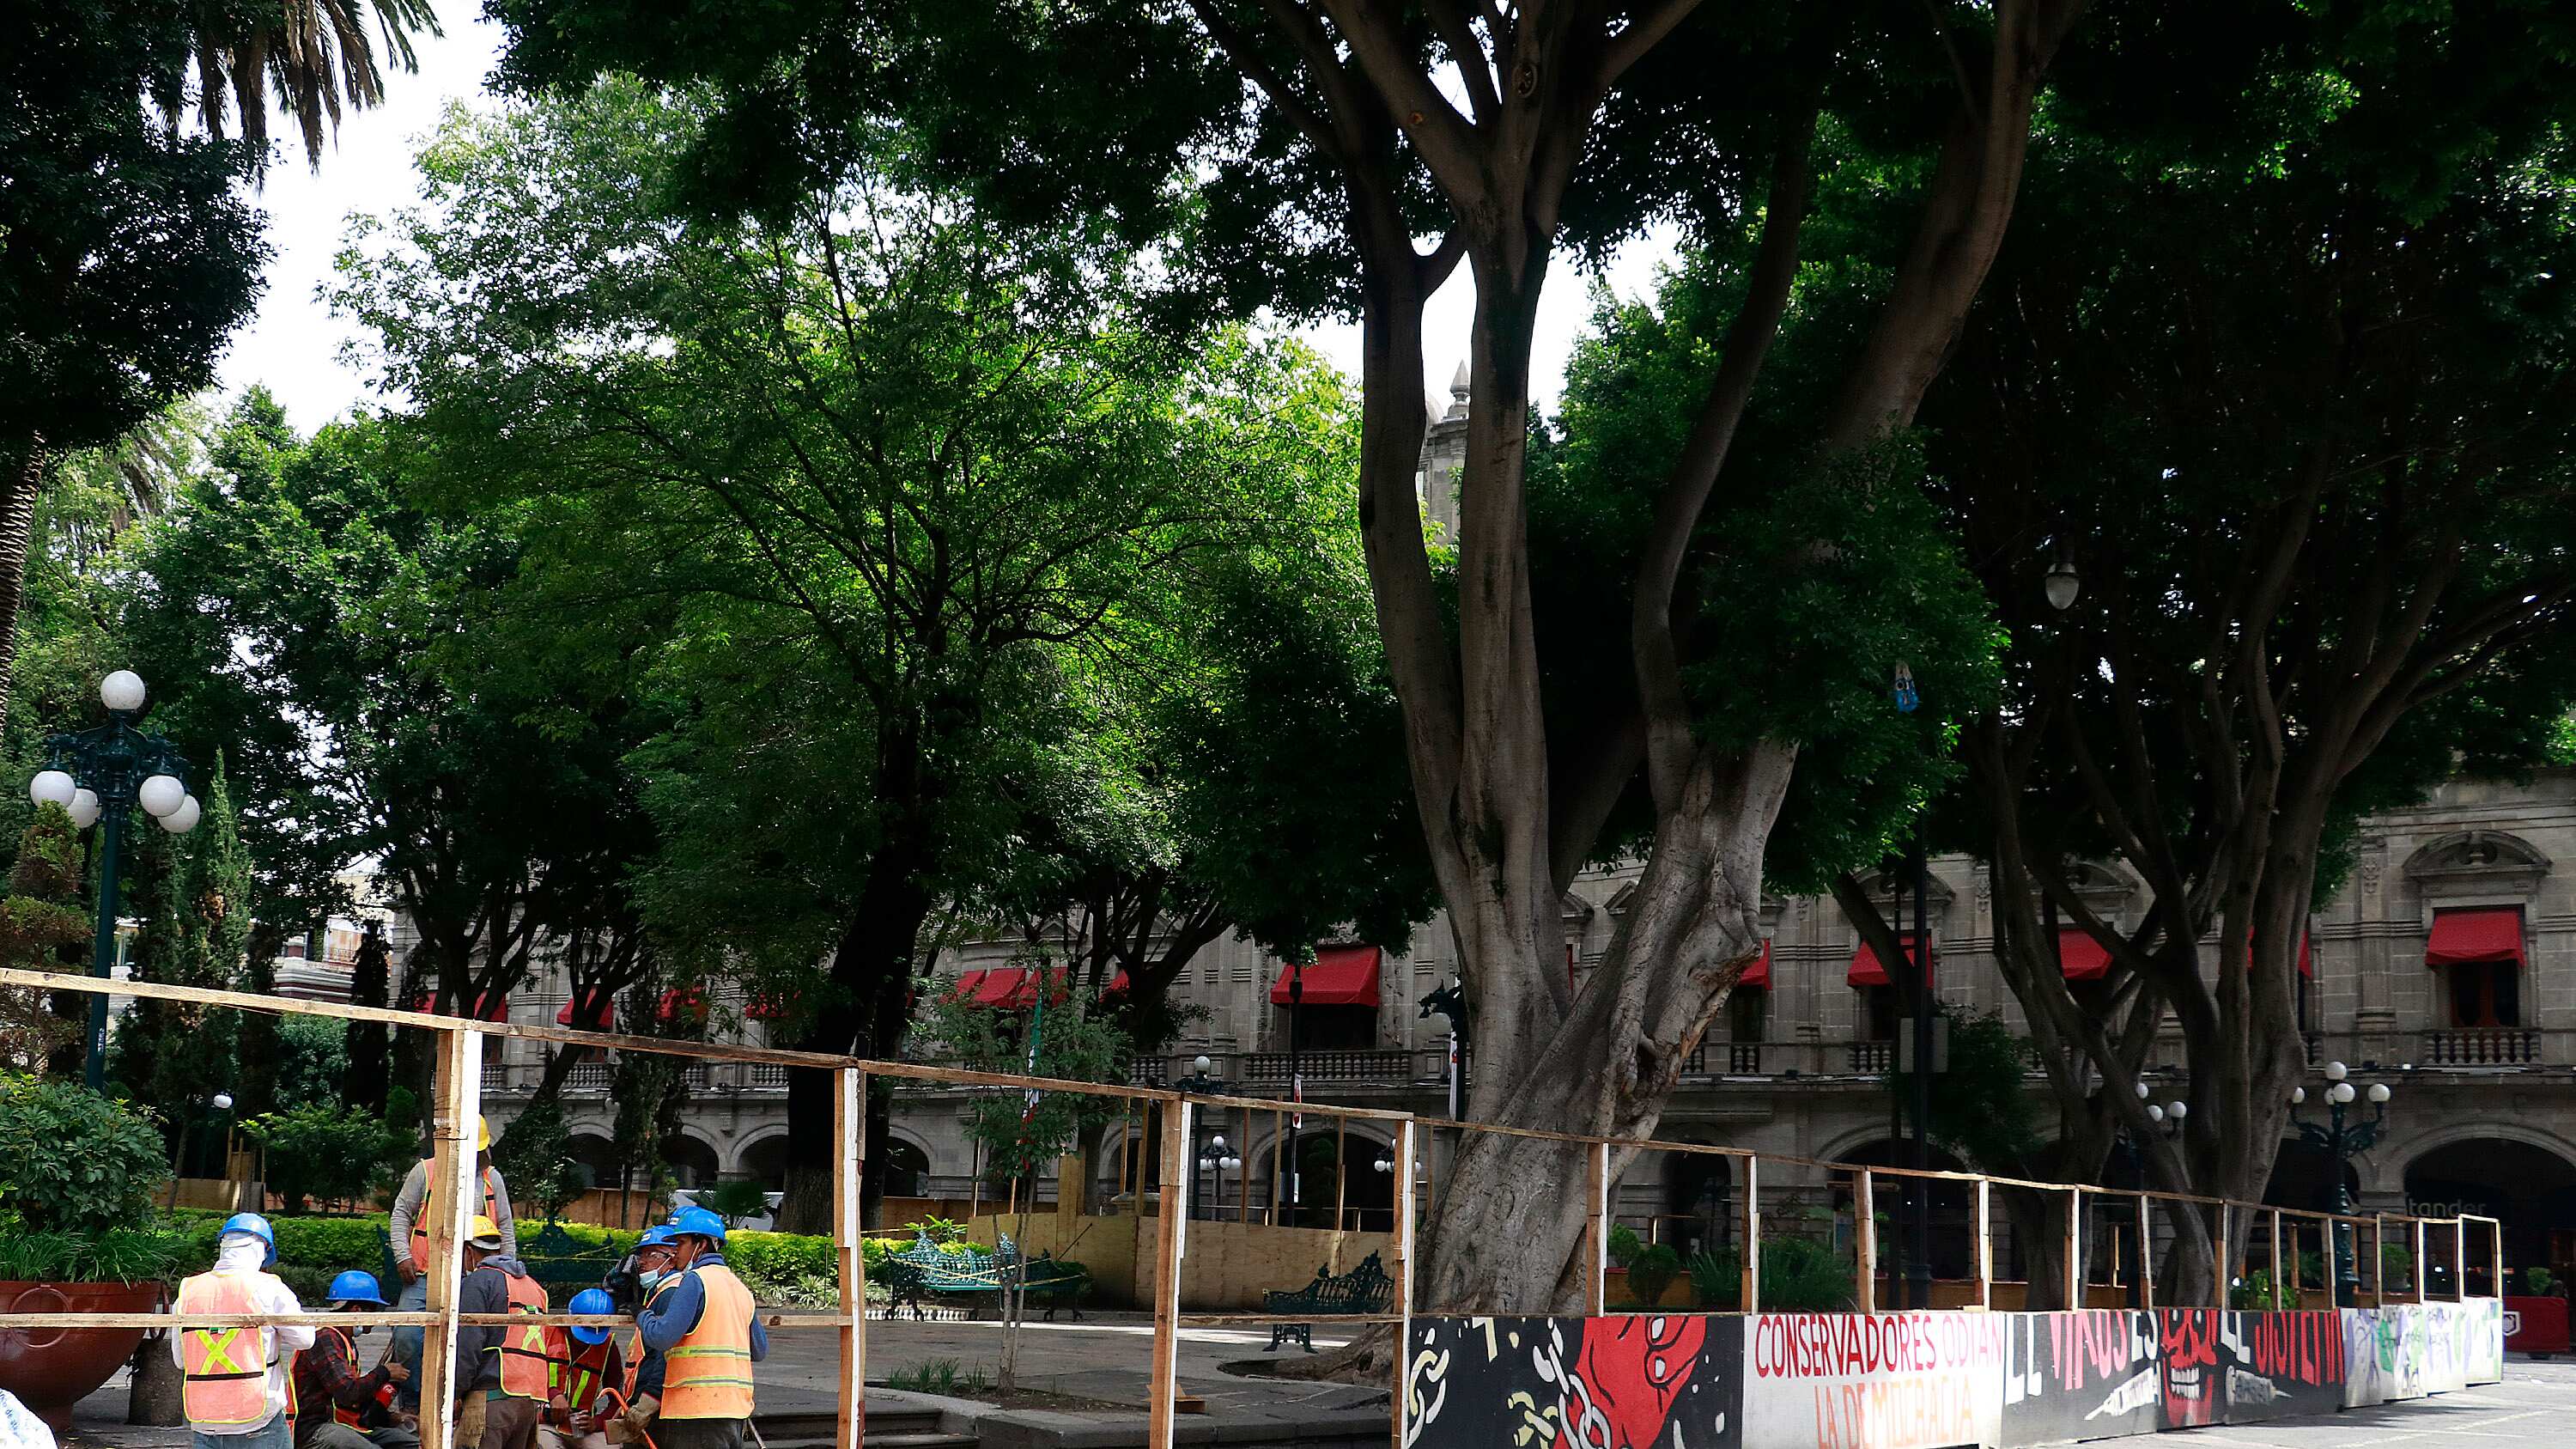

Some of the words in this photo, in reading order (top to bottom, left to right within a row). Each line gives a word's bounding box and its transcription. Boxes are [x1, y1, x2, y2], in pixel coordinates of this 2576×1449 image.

[1755, 1312, 1936, 1379] CONSERVADORES
[1942, 1313, 2002, 1368] ODIAN
[1814, 1385, 1838, 1449] LA
[1842, 1374, 1974, 1449] DEMOCRACIA
